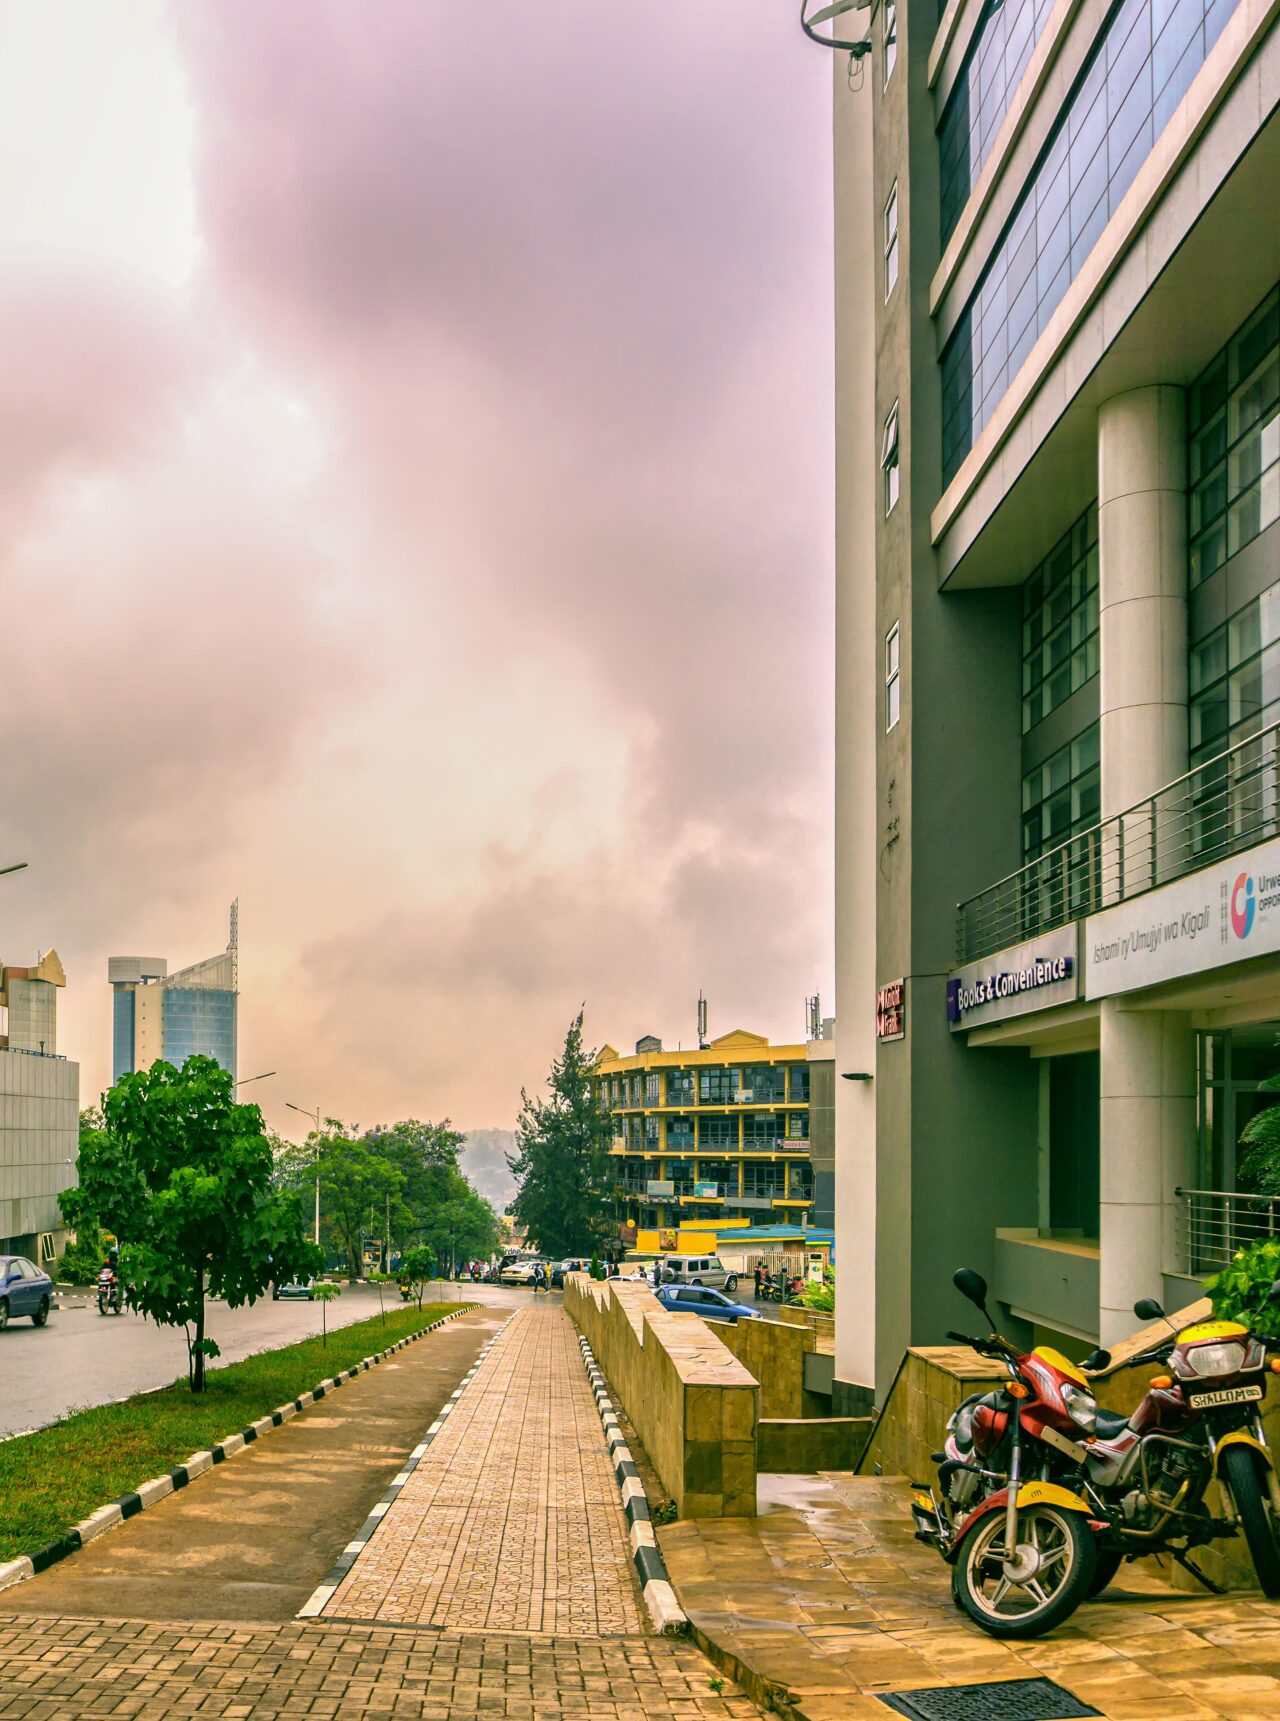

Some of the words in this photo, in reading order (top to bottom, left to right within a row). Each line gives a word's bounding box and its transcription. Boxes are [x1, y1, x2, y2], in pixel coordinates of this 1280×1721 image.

[1093, 937, 1121, 964] Ishami
[1121, 923, 1162, 961] ry'Umujyi
[1164, 922, 1179, 942] wa
[1181, 905, 1211, 939] Kigali
[958, 983, 985, 1010] Books
[986, 975, 994, 1001] &
[995, 957, 1066, 998] Convenience
